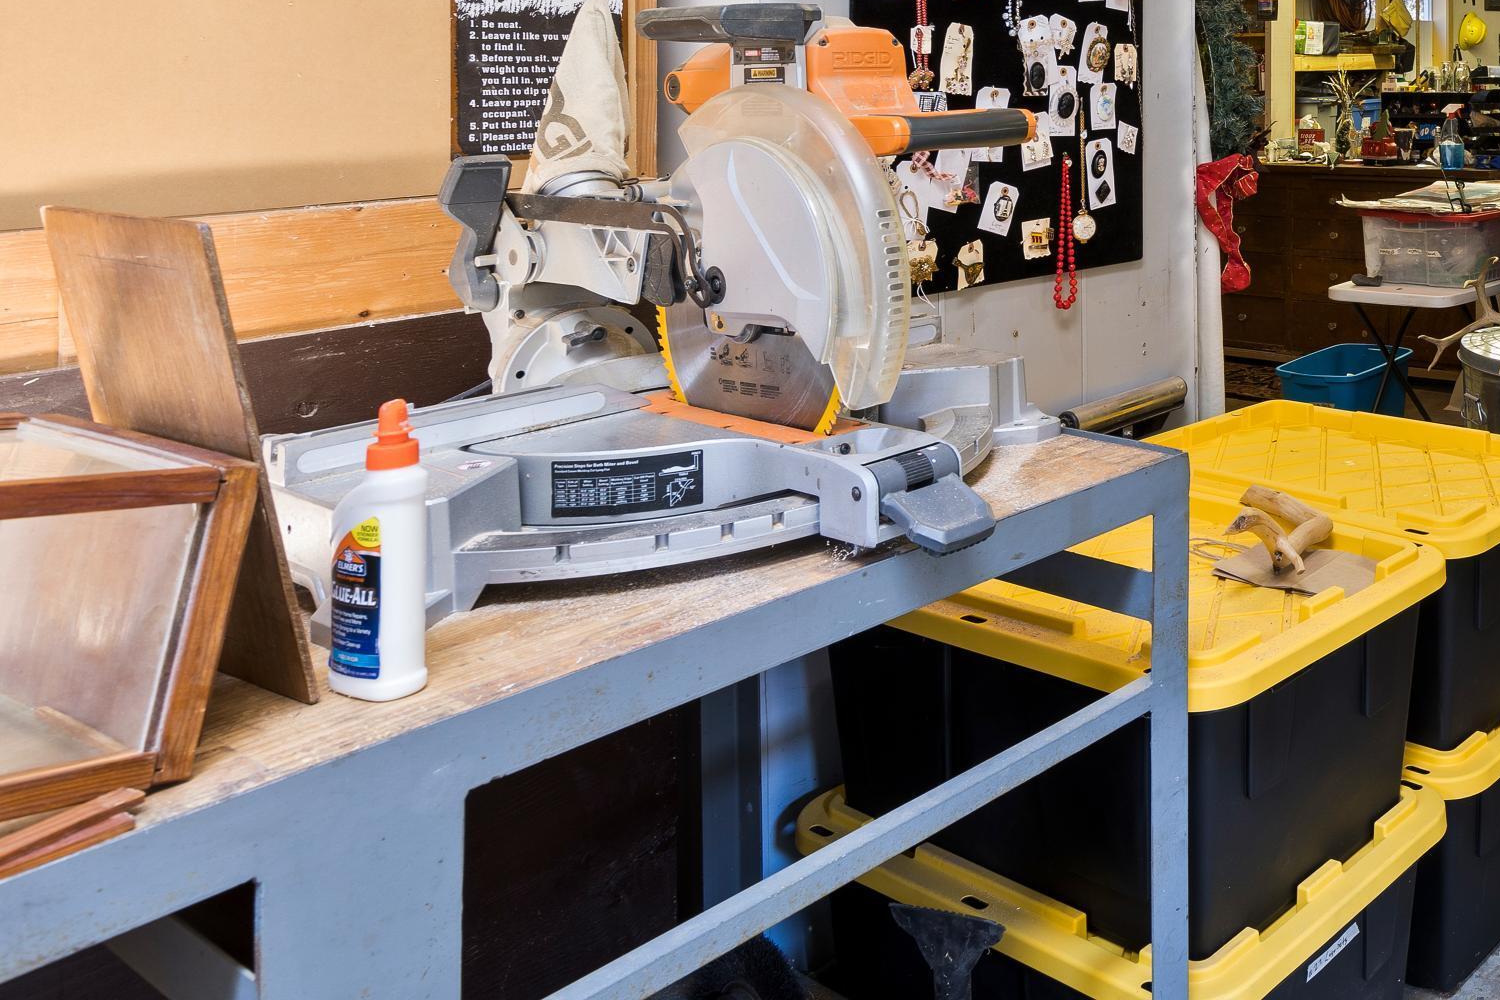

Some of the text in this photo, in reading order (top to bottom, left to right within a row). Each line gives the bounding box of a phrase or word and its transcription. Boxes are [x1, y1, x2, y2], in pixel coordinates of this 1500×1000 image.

[469, 20, 522, 29] 1. Be neat.
[469, 31, 479, 40] 2.
[481, 31, 511, 41] Leave
[512, 31, 520, 40] it
[522, 32, 540, 41] like
[542, 34, 559, 43] you
[481, 43, 526, 51] to find it.
[469, 54, 479, 62] 3.
[481, 54, 514, 63] Before
[515, 56, 532, 65] you
[832, 51, 891, 66] RIDGID
[481, 65, 516, 76] weight
[531, 65, 547, 74] the
[481, 78, 500, 87] you
[501, 77, 519, 85] fall
[482, 88, 540, 97] much to dip
[469, 99, 541, 109] 4. Leave paper
[482, 111, 531, 119] occupant.
[469, 121, 533, 131] 5. Put the lid
[468, 134, 479, 142] 6.
[482, 133, 515, 142] Please
[482, 144, 499, 153] the
[361, 525, 379, 533] NOW
[337, 561, 365, 574] ELMER'S
